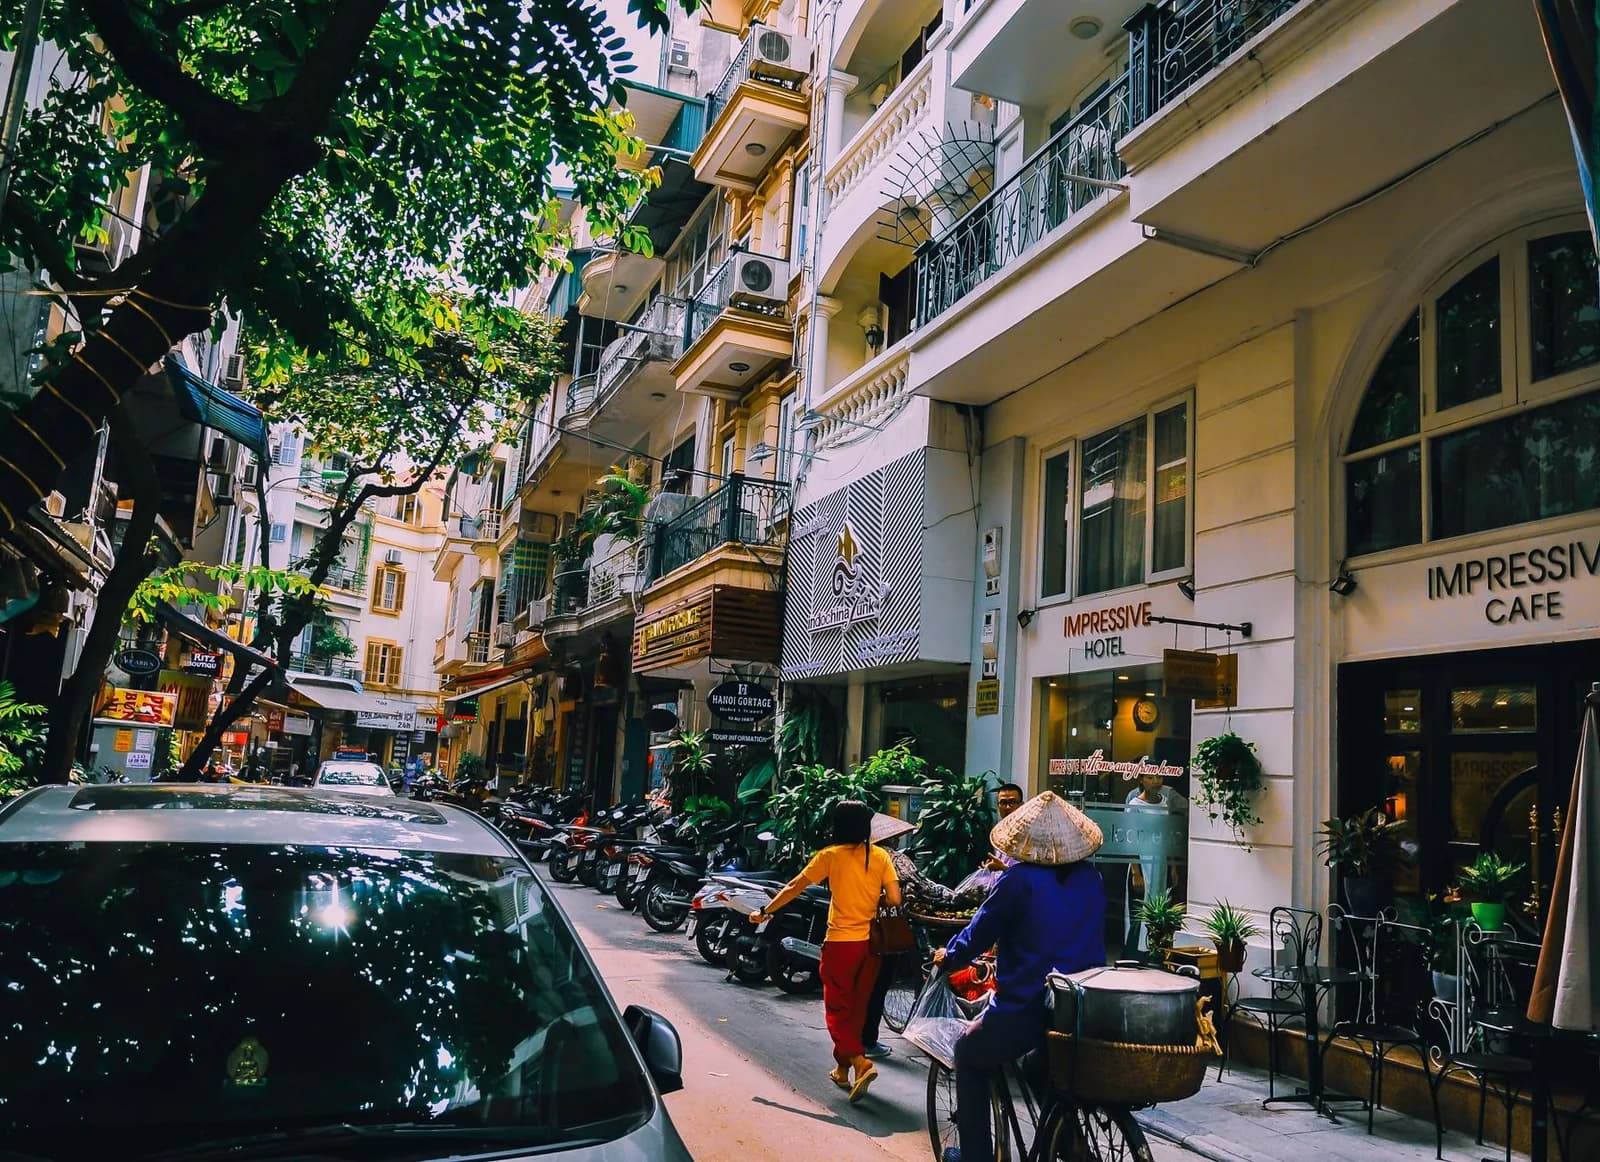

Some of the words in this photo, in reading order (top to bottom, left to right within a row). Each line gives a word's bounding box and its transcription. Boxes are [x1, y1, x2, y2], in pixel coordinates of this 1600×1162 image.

[1063, 601, 1151, 638] IMPRESSIVE
[1485, 590, 1562, 624] CAFE
[1084, 636, 1125, 659] HOTEL
[712, 695, 736, 705] HANOI
[1087, 749, 1114, 773] Home
[1156, 760, 1185, 777] home
